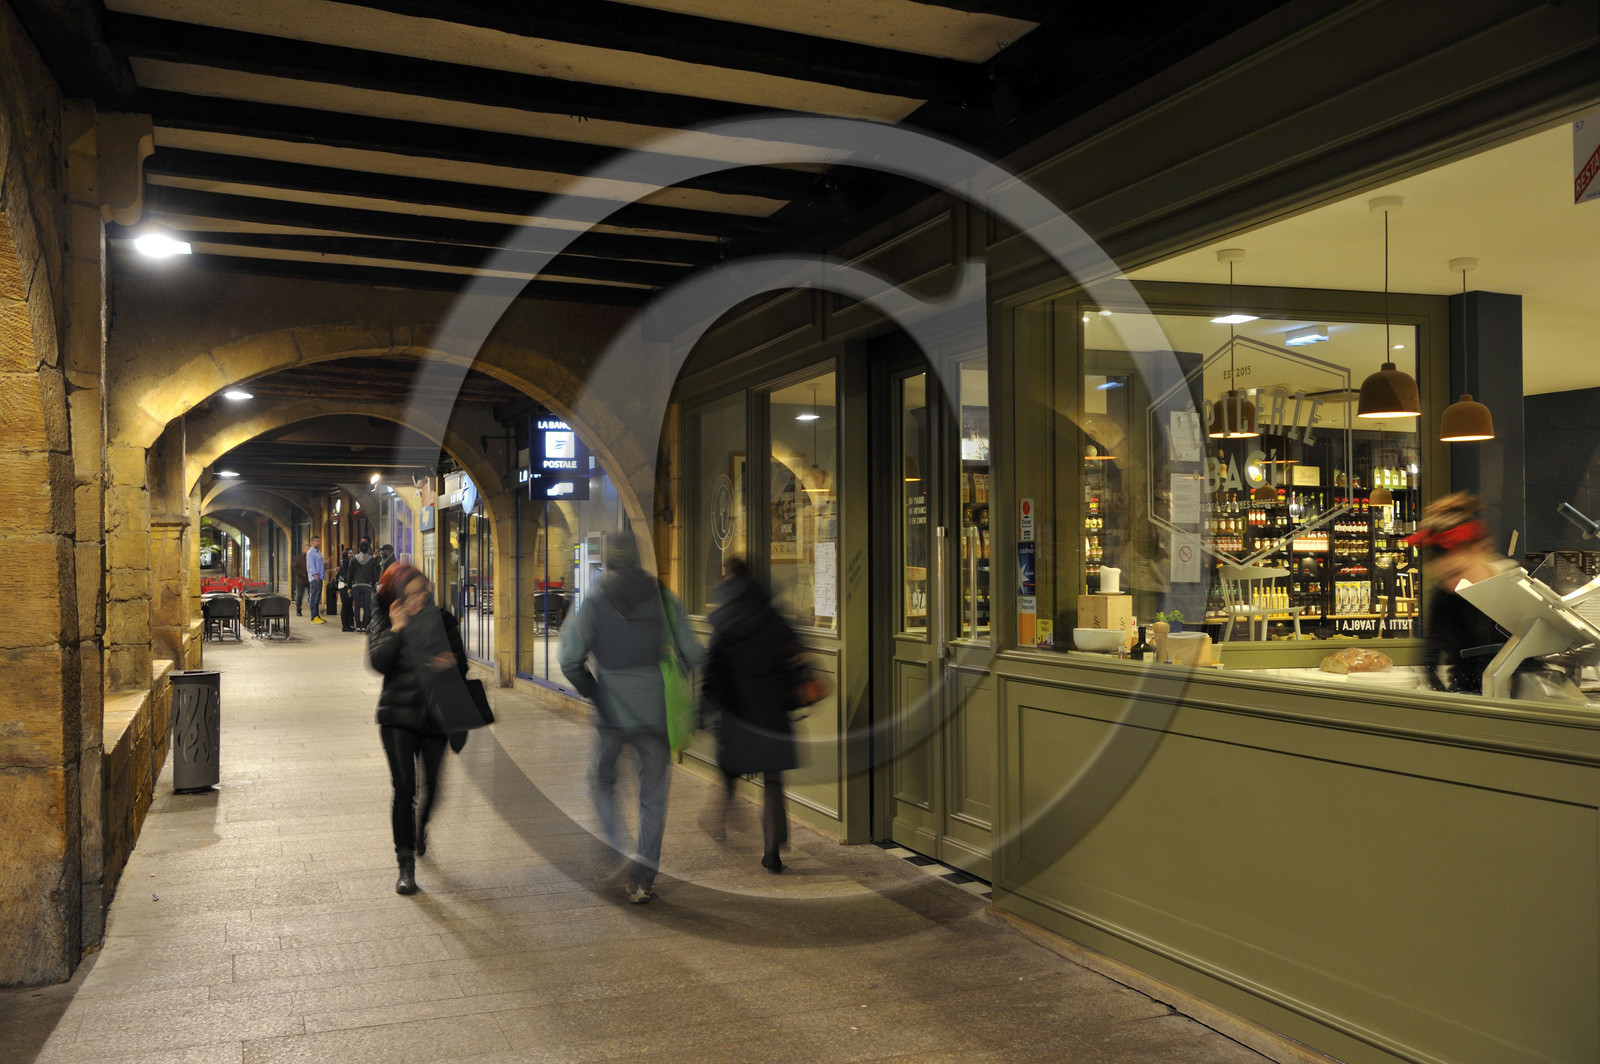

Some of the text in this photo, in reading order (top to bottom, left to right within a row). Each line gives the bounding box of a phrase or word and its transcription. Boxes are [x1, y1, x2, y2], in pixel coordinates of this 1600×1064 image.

[1575, 120, 1584, 132] 57
[1237, 365, 1251, 378] 2015
[537, 420, 548, 430] LA
[543, 460, 578, 470] POSTALE
[1204, 448, 1278, 494] BACI
